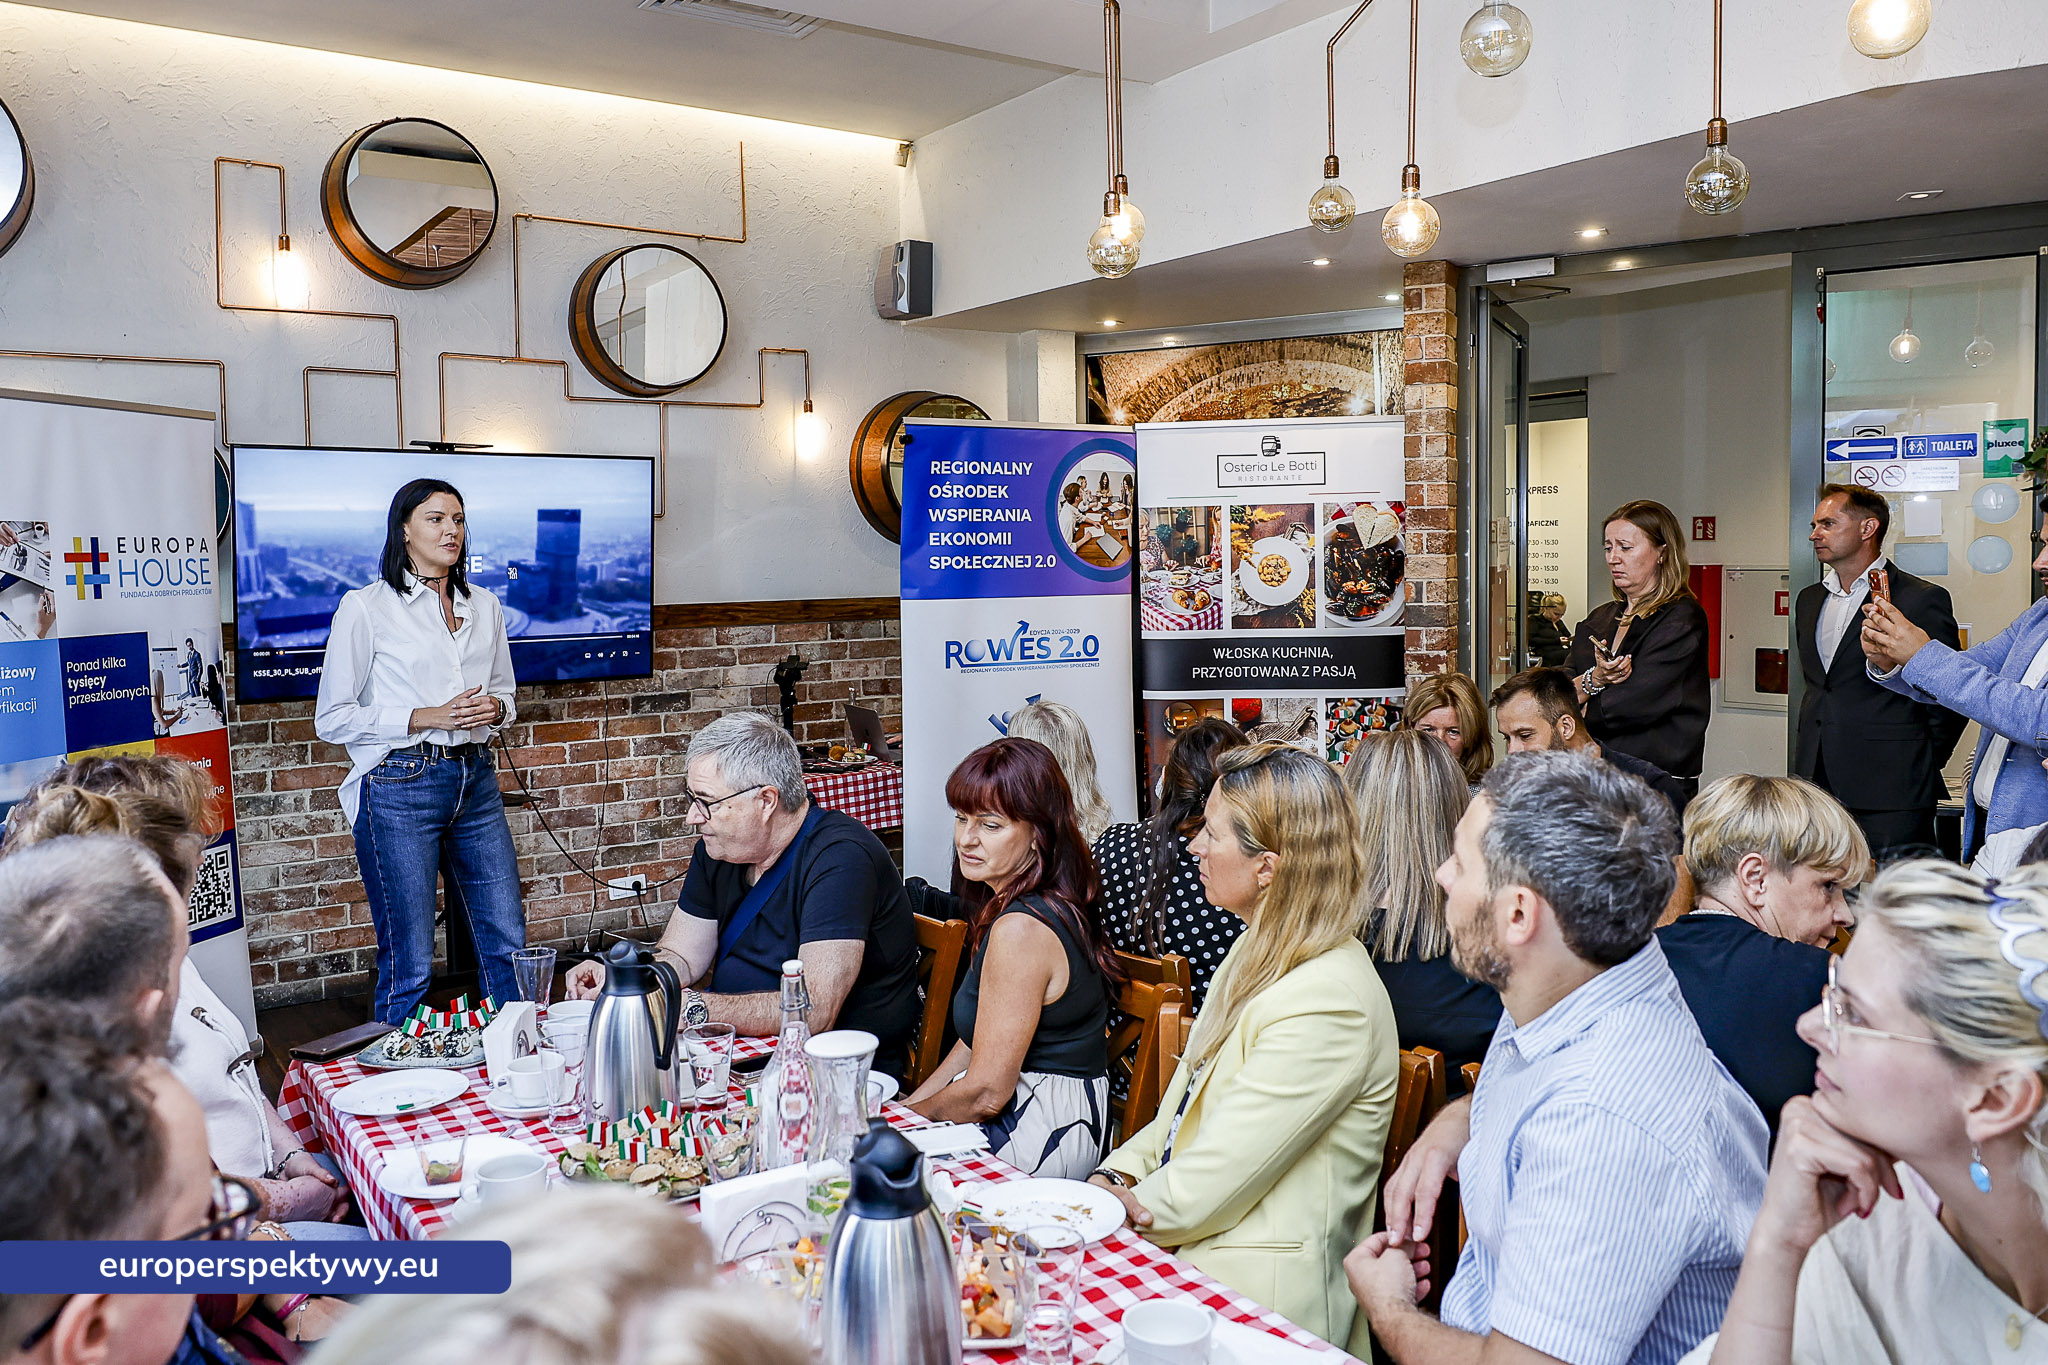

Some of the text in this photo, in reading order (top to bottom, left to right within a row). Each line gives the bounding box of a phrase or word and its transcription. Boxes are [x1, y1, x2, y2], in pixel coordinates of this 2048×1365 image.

[1931, 439, 1974, 452] TOALETA
[1986, 439, 2025, 451] pluxee
[930, 460, 1033, 476] REGIONALNY
[1223, 460, 1318, 473] Osteria Le Botti
[1237, 474, 1303, 482] RISTORANTE
[928, 480, 1009, 499] OŚRODEK
[928, 508, 1032, 522] WSPIERANIA
[117, 537, 209, 554] EUROPA
[929, 532, 1012, 546] EKONOMII
[929, 554, 1057, 570] SPOŁECZNEJ 2.0
[118, 558, 211, 588] HOUSE
[120, 587, 213, 599] FUNDACJA DOBRYCH PROJEKTÓW
[944, 634, 1100, 669] ROWES 2.0
[1212, 647, 1334, 659] WŁOSKA KUCHNIA,
[66, 656, 126, 673] Ponad kilka
[0, 666, 37, 681] iżowy
[1192, 665, 1357, 680] PRZYGOTOWANA Z PASJĄ
[67, 674, 107, 693] tysięcy
[69, 684, 150, 709] przeszkolonych
